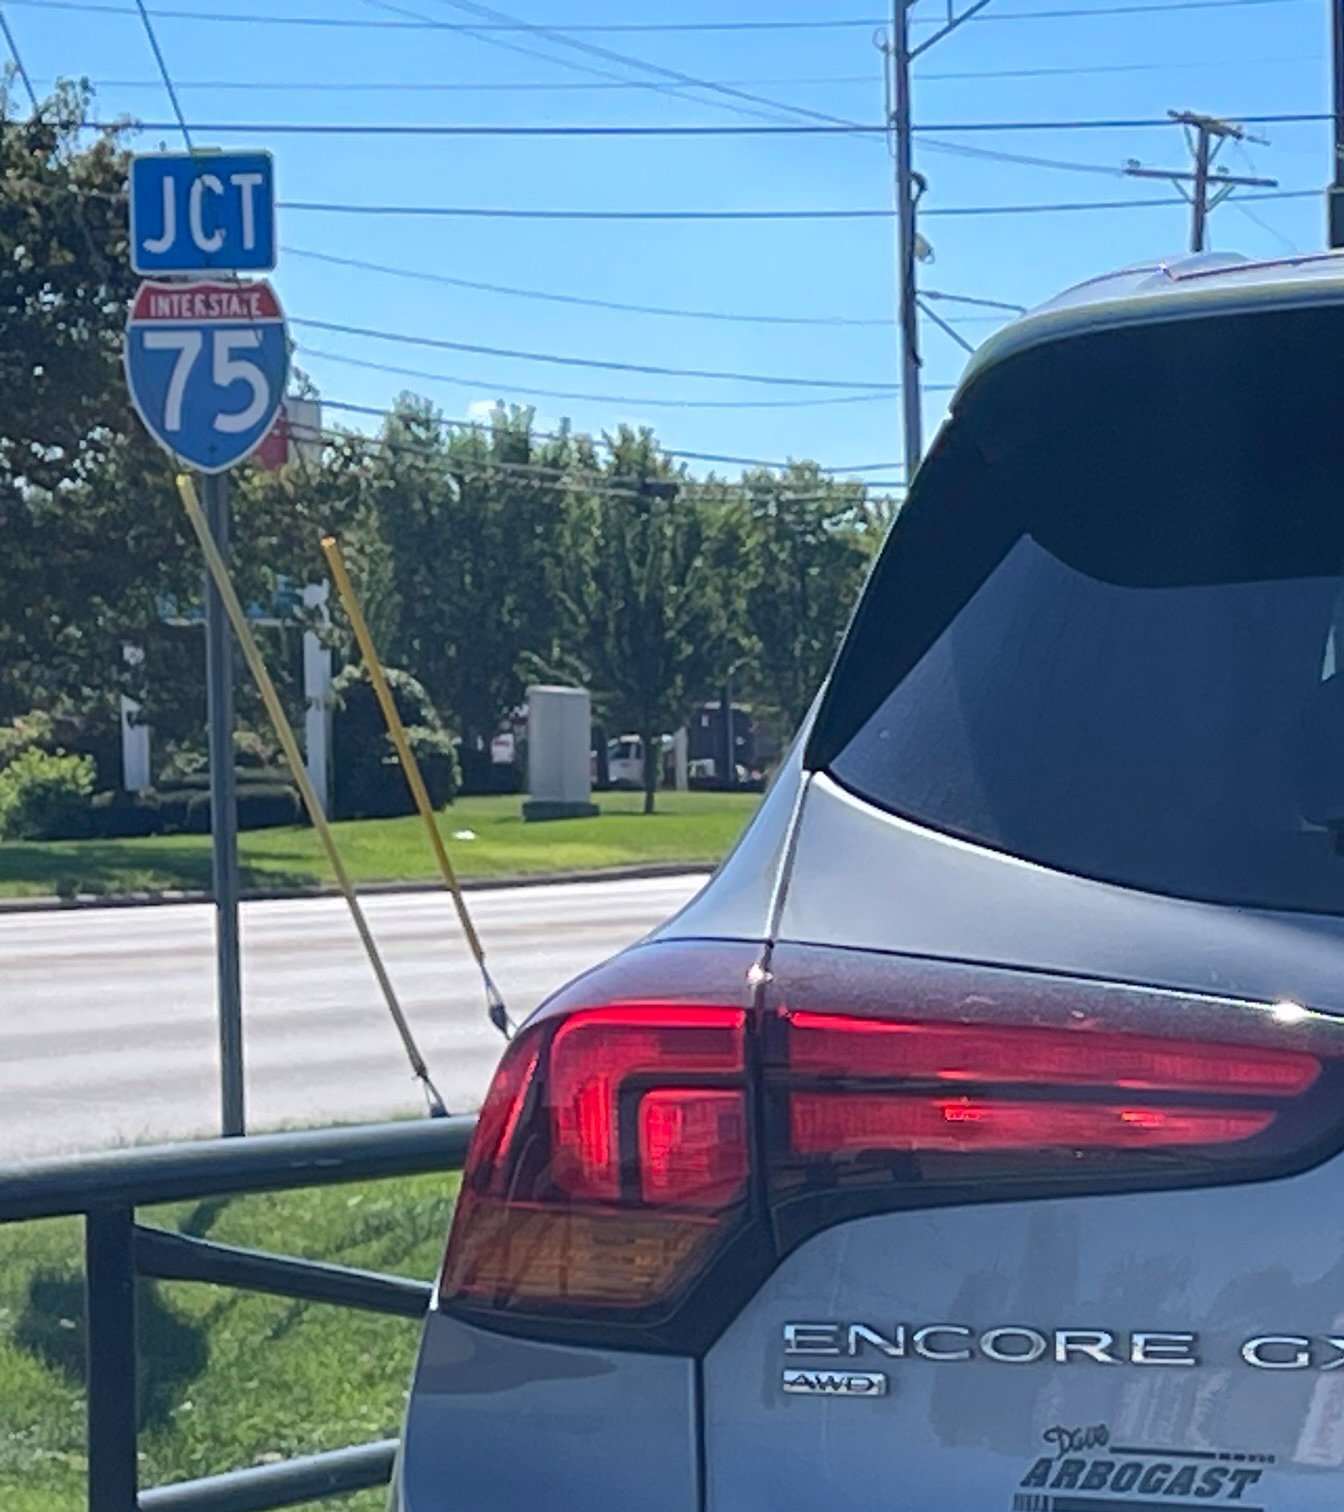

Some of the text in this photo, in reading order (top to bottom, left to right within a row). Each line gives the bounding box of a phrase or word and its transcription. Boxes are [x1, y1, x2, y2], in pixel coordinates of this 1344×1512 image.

[143, 174, 263, 253] JCT
[150, 293, 262, 318] INTERSTATE
[143, 331, 270, 433] 75
[783, 1323, 1197, 1366] ENCORE
[785, 1373, 877, 1394] AWD
[1043, 1424, 1110, 1460] Dave
[1019, 1457, 1263, 1499] ARBOGAST
